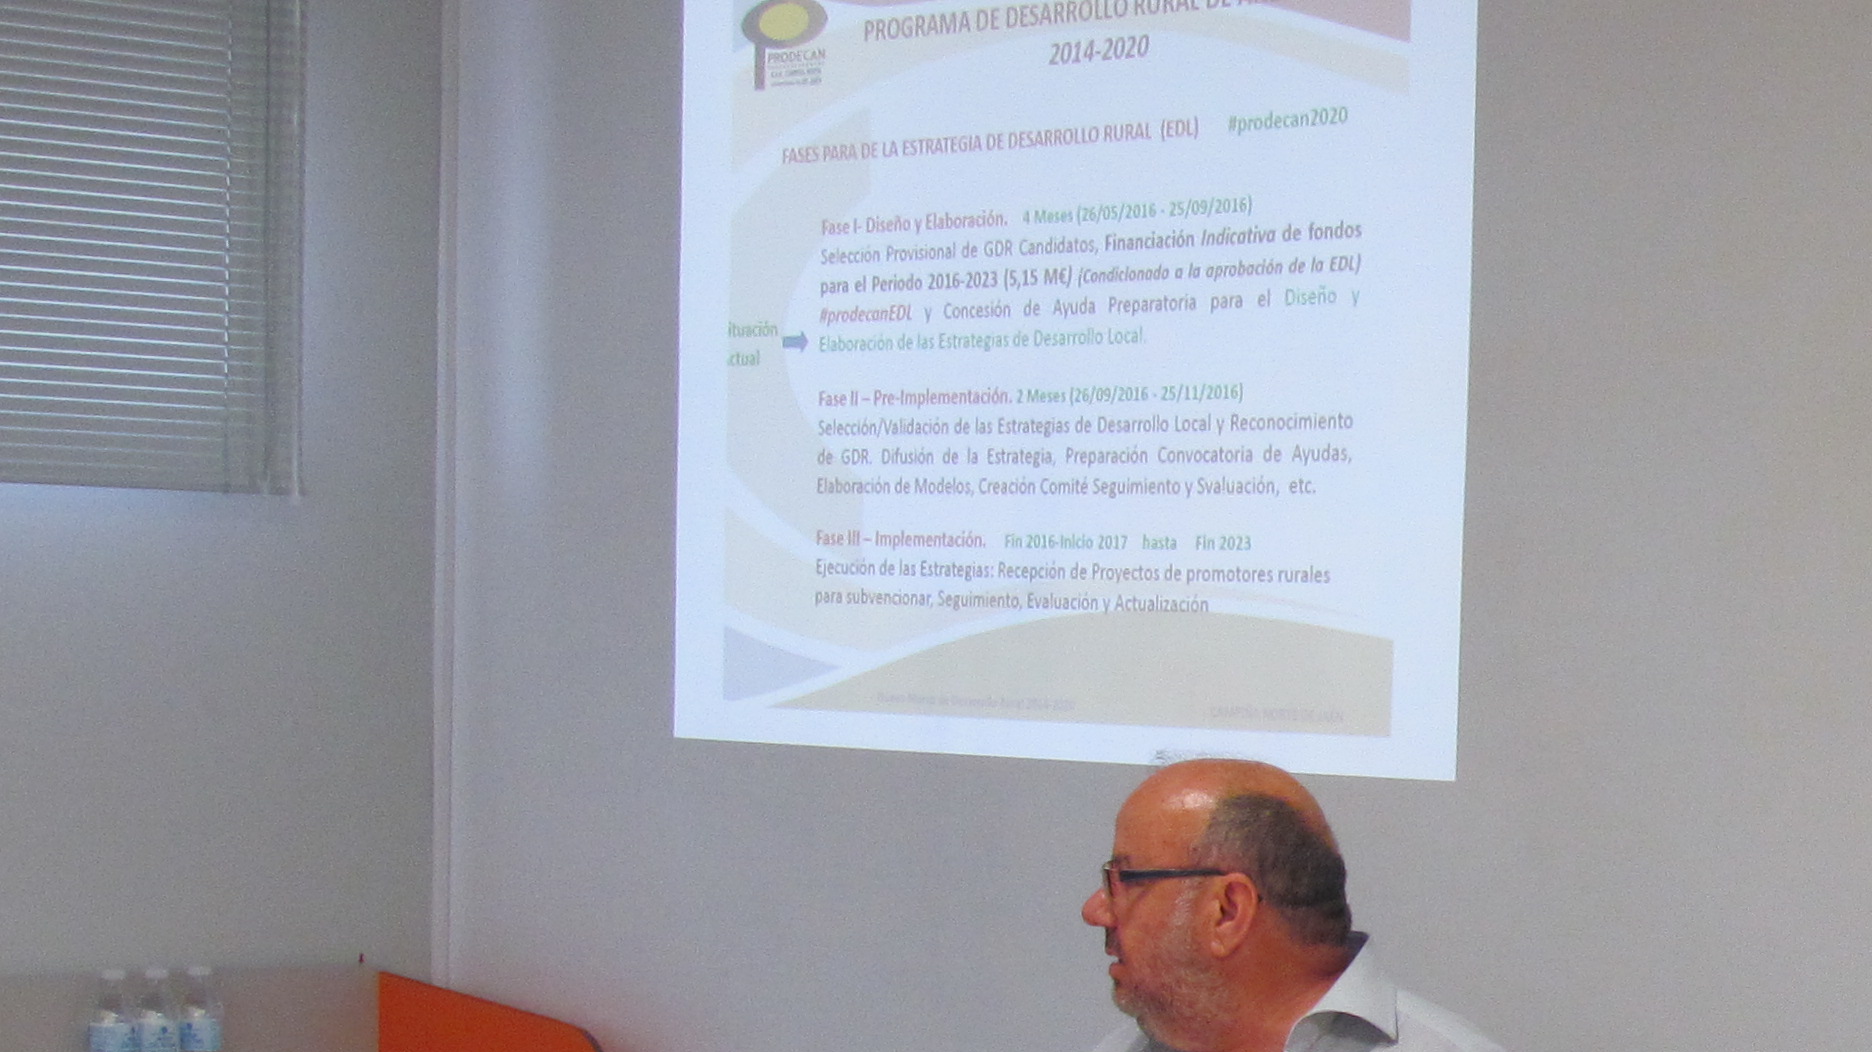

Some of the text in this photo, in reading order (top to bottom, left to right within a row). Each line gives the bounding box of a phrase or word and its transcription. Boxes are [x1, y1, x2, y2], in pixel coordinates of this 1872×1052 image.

[864, 11, 971, 42] PROGRAMA
[976, 9, 1000, 31] DE
[1006, 0, 1128, 29] DESARROLLO
[768, 47, 827, 63] PRODECAN
[1048, 34, 1150, 66] 2014-2020
[1227, 105, 1350, 136] #prodecan2020
[781, 115, 1199, 165] FASES PARA DE LA ESTRATEGIA DE DESARROLLO RURAL (EDL)
[821, 218, 851, 236] Fase
[865, 213, 911, 234] Diseño
[925, 211, 1008, 231] Elaboración.
[1034, 208, 1074, 225] Meses
[820, 219, 1363, 265] Selección Provisional de GDR Candidatos, Financiación Indicativa de fondos
[820, 278, 850, 298] para
[854, 274, 867, 293] el
[871, 271, 923, 293] Periodo
[927, 271, 998, 291] 2016-2023
[1003, 268, 1038, 292] (5,15
[1078, 261, 1169, 288] (Condicionado
[1188, 262, 1201, 279] la
[1205, 258, 1284, 282] aprobación
[1288, 256, 1306, 275] de
[1311, 255, 1325, 273] la
[1329, 253, 1363, 274] EDL)
[943, 301, 1012, 320] Concesión
[1023, 299, 1041, 317] de
[1052, 297, 1096, 319] Ayuda
[1108, 293, 1197, 317] Preparatoria
[1210, 292, 1244, 314] para
[1257, 289, 1272, 307] el
[1284, 285, 1338, 306] Diseño
[819, 333, 894, 353] Elaboración
[897, 333, 913, 351] de
[916, 332, 935, 351] las
[938, 330, 1009, 354] Estrategias
[1012, 329, 1029, 348] de
[1033, 326, 1104, 347] Desarrollo
[727, 350, 761, 367] ctual
[818, 389, 848, 407] Fase
[873, 387, 1012, 410] Pre-Implementación.
[1026, 388, 1066, 403] Meses
[818, 411, 1354, 438] Selección/Validación de las Estrategias de Desarrollo Local Reconocimiento
[817, 442, 1353, 468] de GDR. Difusión de la Estrategia, Preparación Convocatoria de Ayudas,
[816, 476, 891, 495] Elaboración
[894, 476, 910, 495] de
[914, 476, 975, 497] Modelos,
[978, 476, 1036, 496] Creación
[1039, 476, 1089, 496] Comité
[1092, 475, 1181, 498] Seguimiento
[1288, 477, 1316, 495] etc.
[816, 529, 845, 547] Fase
[875, 529, 986, 551] Implementación.
[1004, 533, 1023, 549] Fin
[1097, 534, 1128, 551] 2017
[1142, 533, 1178, 551] hasta
[1195, 533, 1215, 551] Fin
[1219, 534, 1252, 551] 2023
[815, 557, 1332, 585] Ejecución de las Estrategias: Recepción de Proyectos de promotores rurales
[815, 588, 1210, 614] para subvencionar, Seguimiento, Evaluación Actualización
